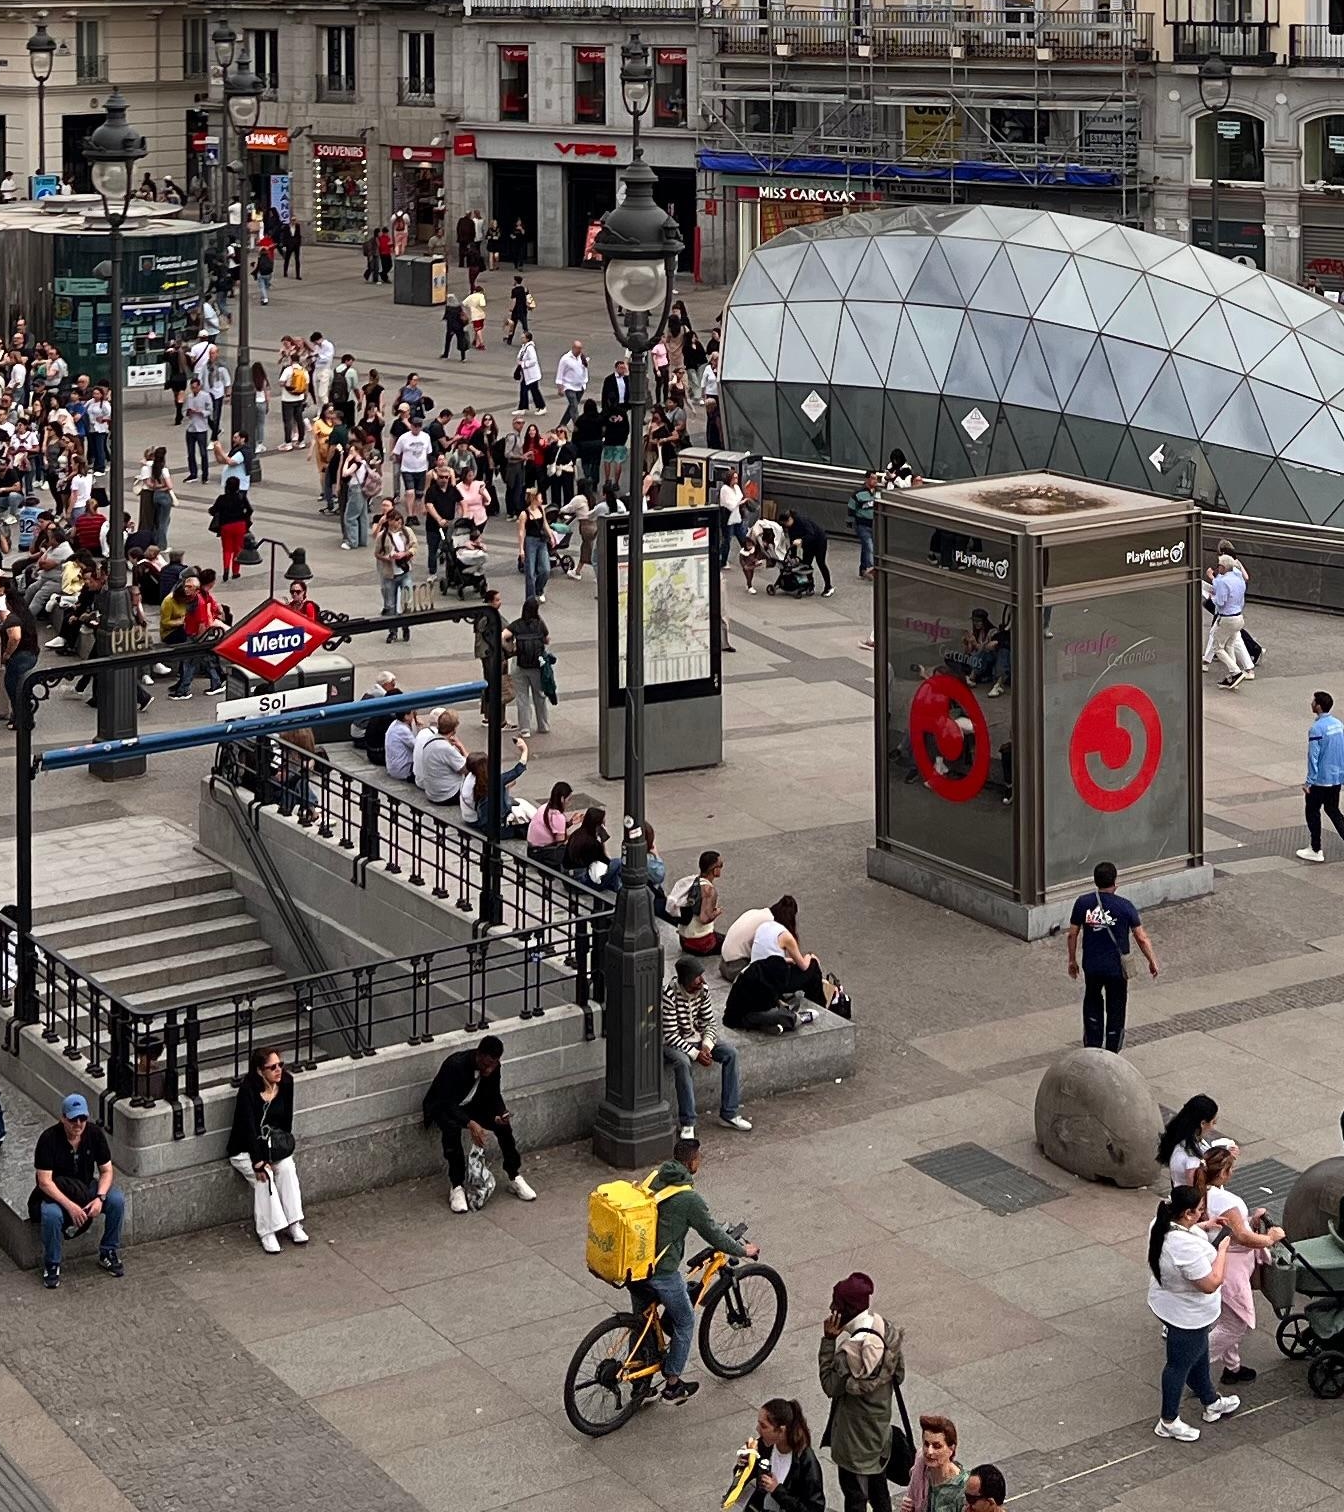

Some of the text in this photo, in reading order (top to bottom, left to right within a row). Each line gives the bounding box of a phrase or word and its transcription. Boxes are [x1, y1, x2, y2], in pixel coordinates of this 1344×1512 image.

[660, 51, 688, 62] VIPS
[317, 145, 364, 158] SOUVENIRS
[554, 143, 618, 158] VIPS
[759, 186, 856, 202] MISS CARCASAS
[956, 550, 994, 570] PlayRenfe
[1126, 548, 1169, 564] PlayRenfe
[906, 616, 950, 642] renfe
[252, 634, 300, 653] Metro
[1065, 629, 1120, 656] renfe
[260, 694, 286, 712] Sol
